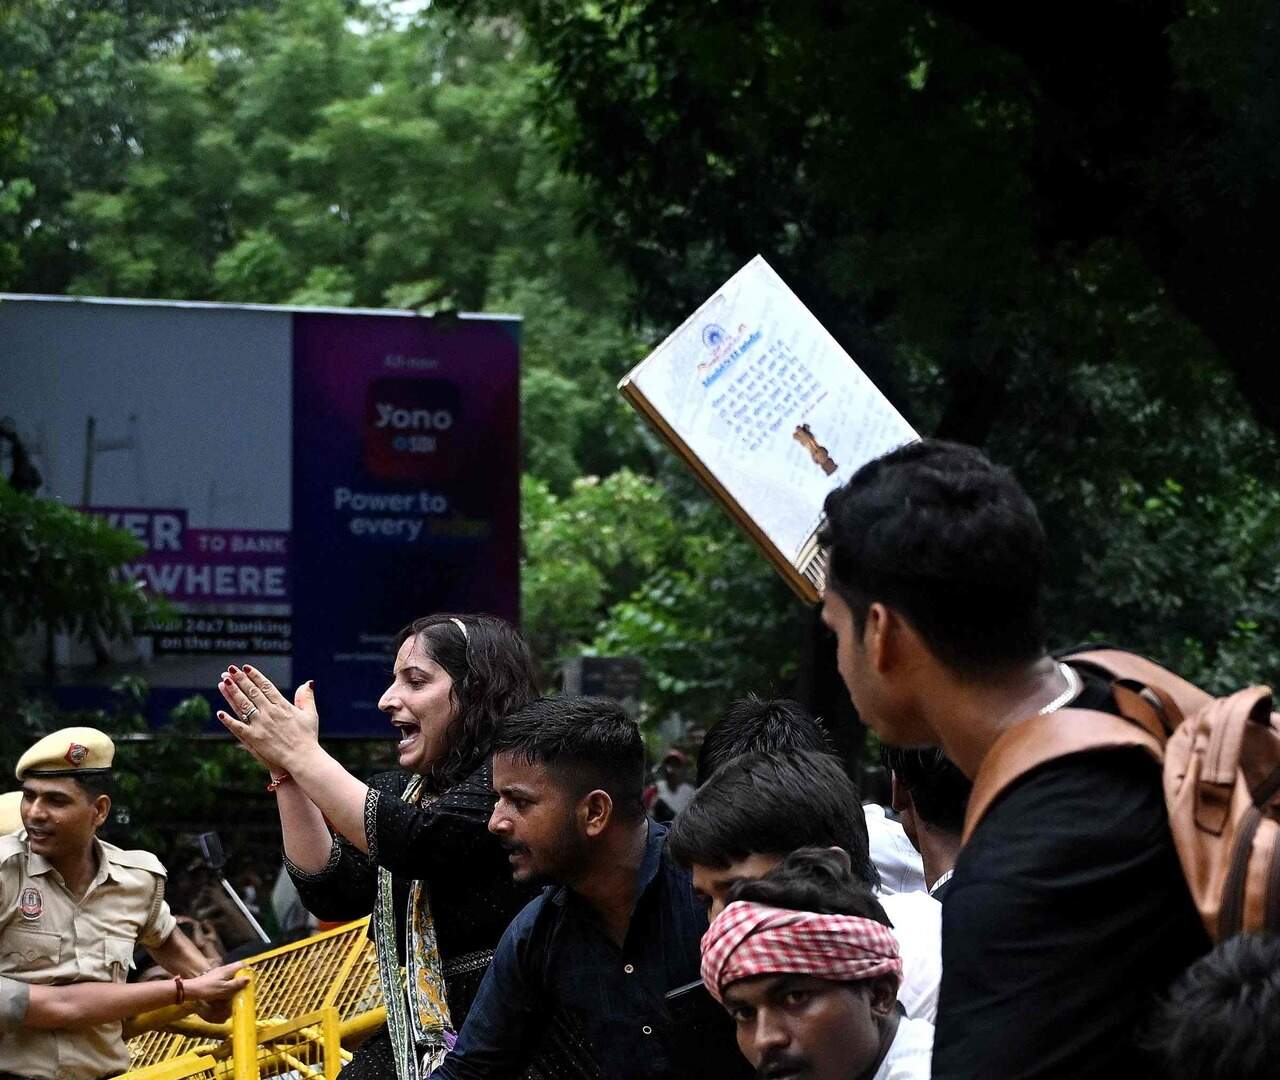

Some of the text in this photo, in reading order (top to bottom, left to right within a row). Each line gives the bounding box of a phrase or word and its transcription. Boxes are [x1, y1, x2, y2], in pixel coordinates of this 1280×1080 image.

[333, 486, 448, 513] Power to
[350, 517, 423, 541] every
[198, 535, 227, 554] TO
[230, 536, 287, 553] BANK
